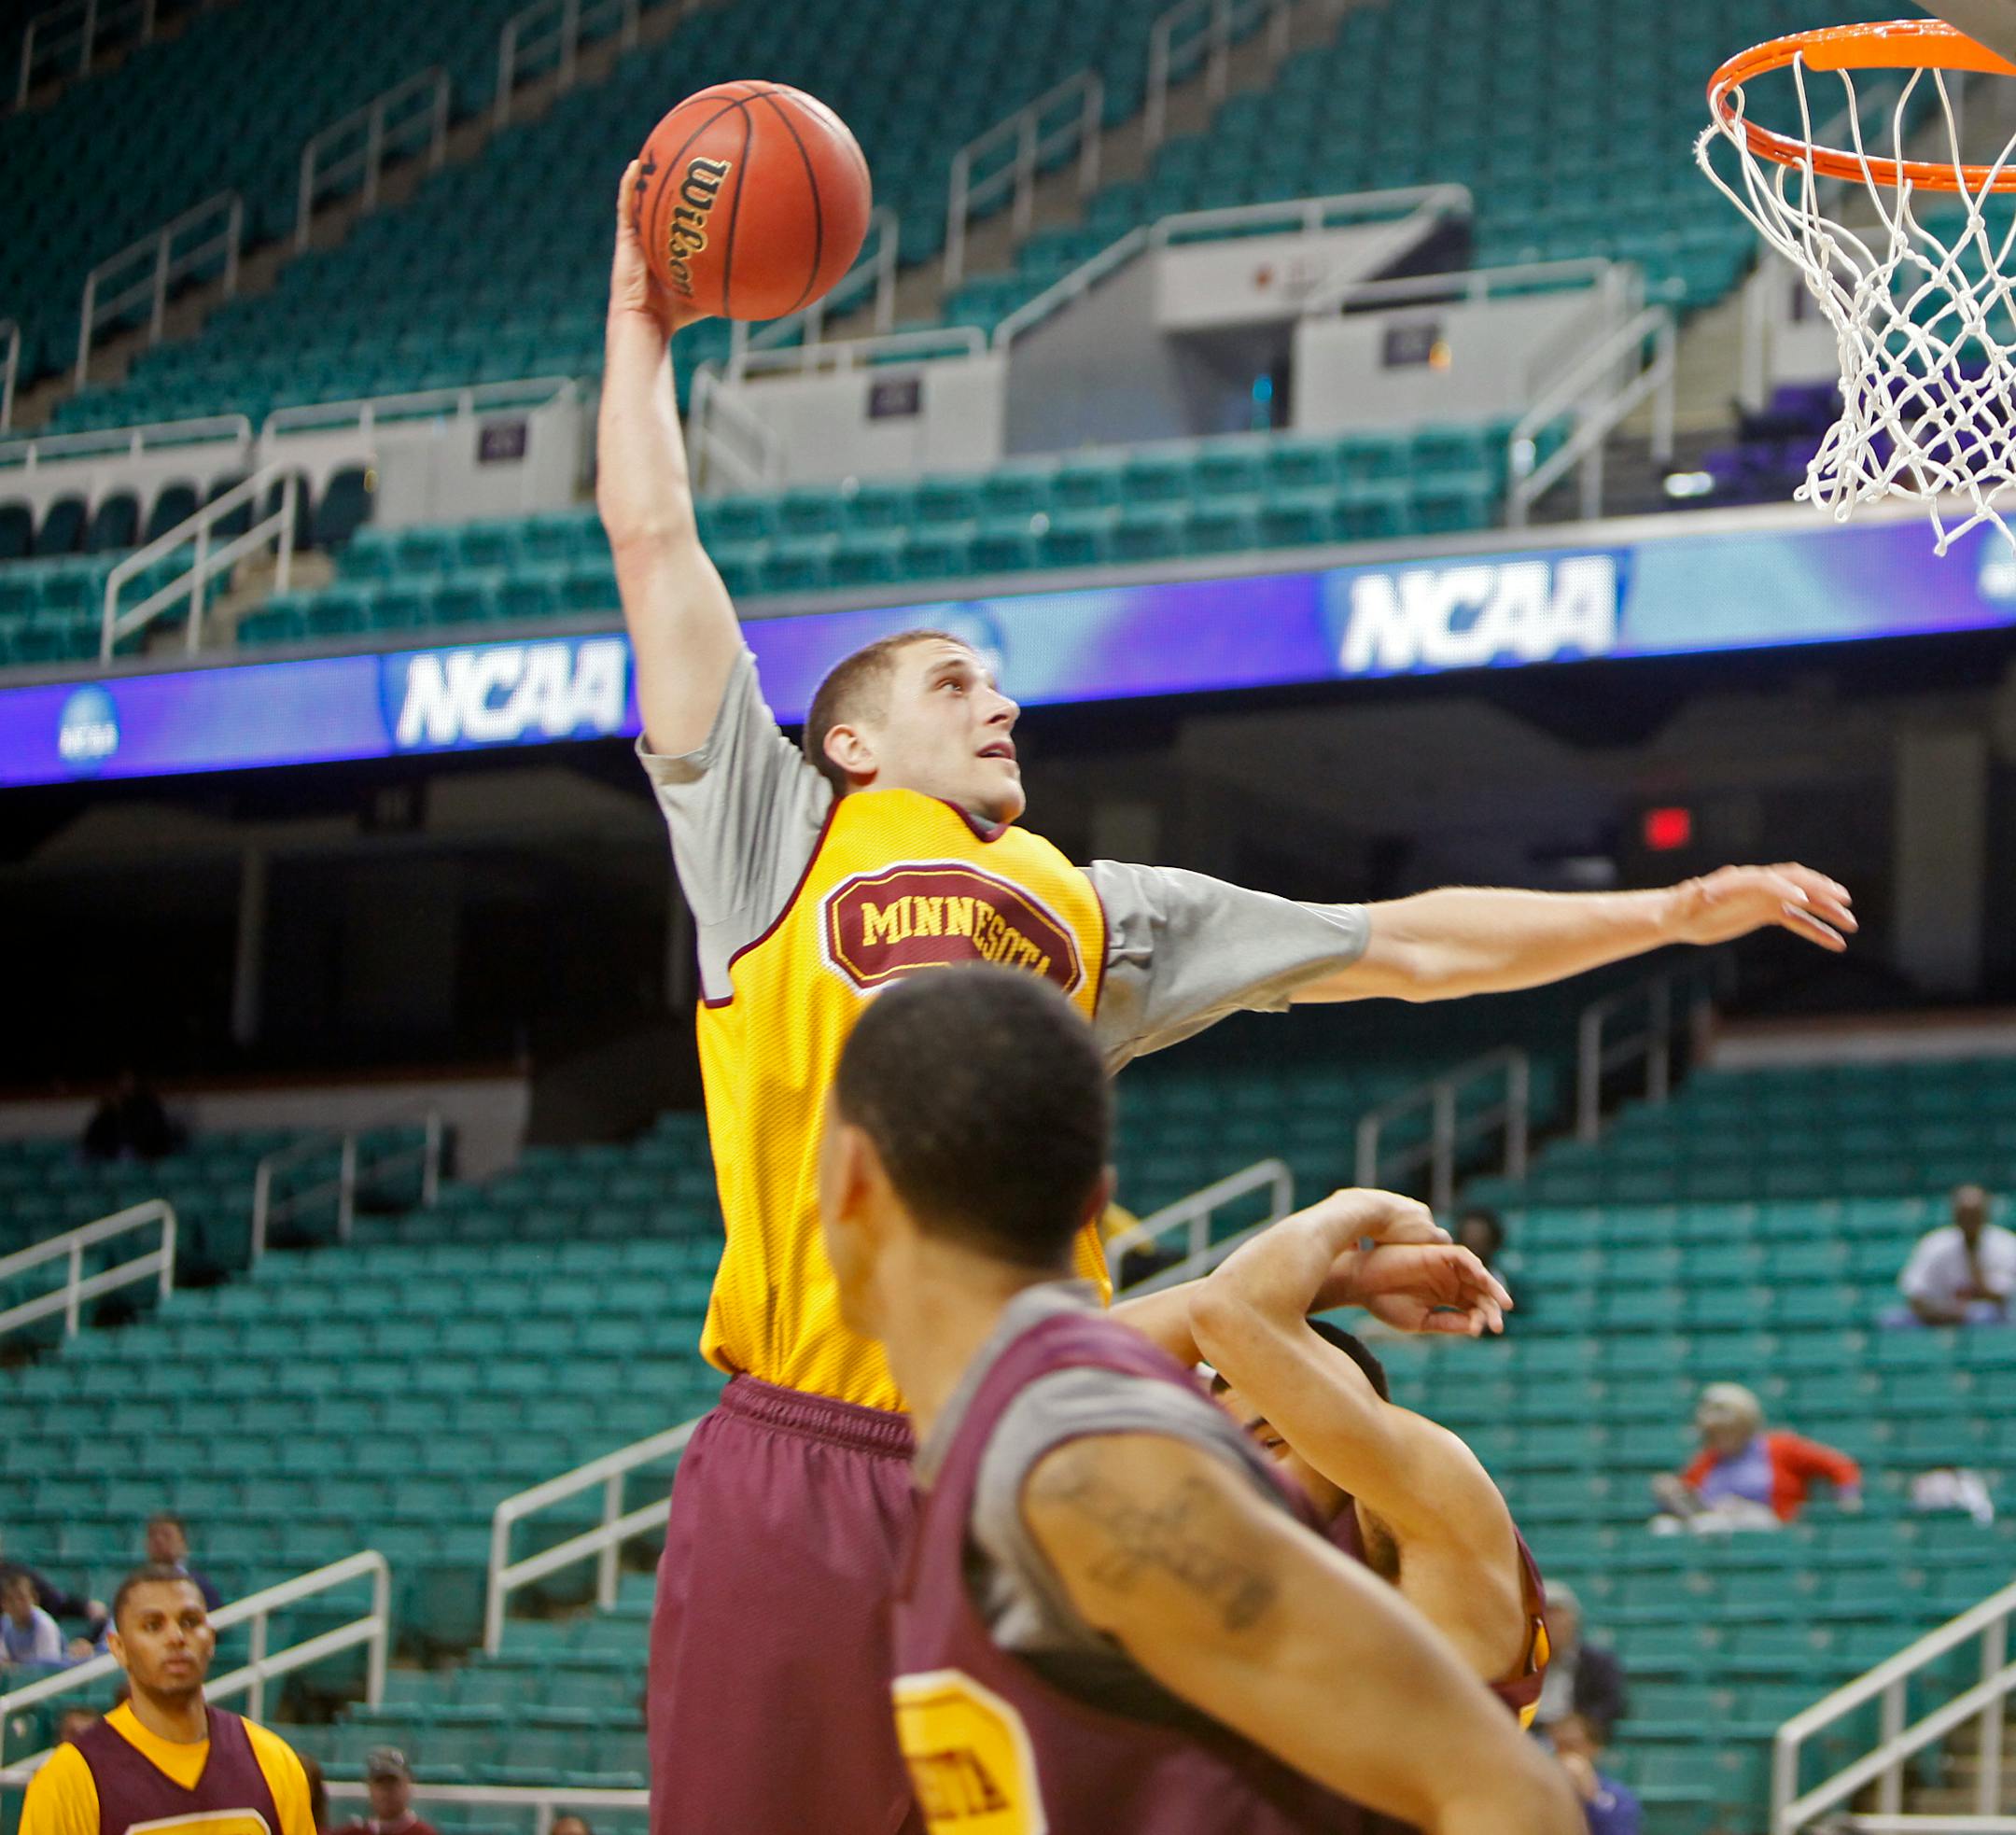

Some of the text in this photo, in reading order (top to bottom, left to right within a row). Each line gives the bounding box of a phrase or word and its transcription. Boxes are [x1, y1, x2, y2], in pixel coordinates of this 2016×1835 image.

[668, 157, 732, 298] Wilson
[1340, 555, 1617, 672] NCAA
[397, 639, 625, 746] NCAA
